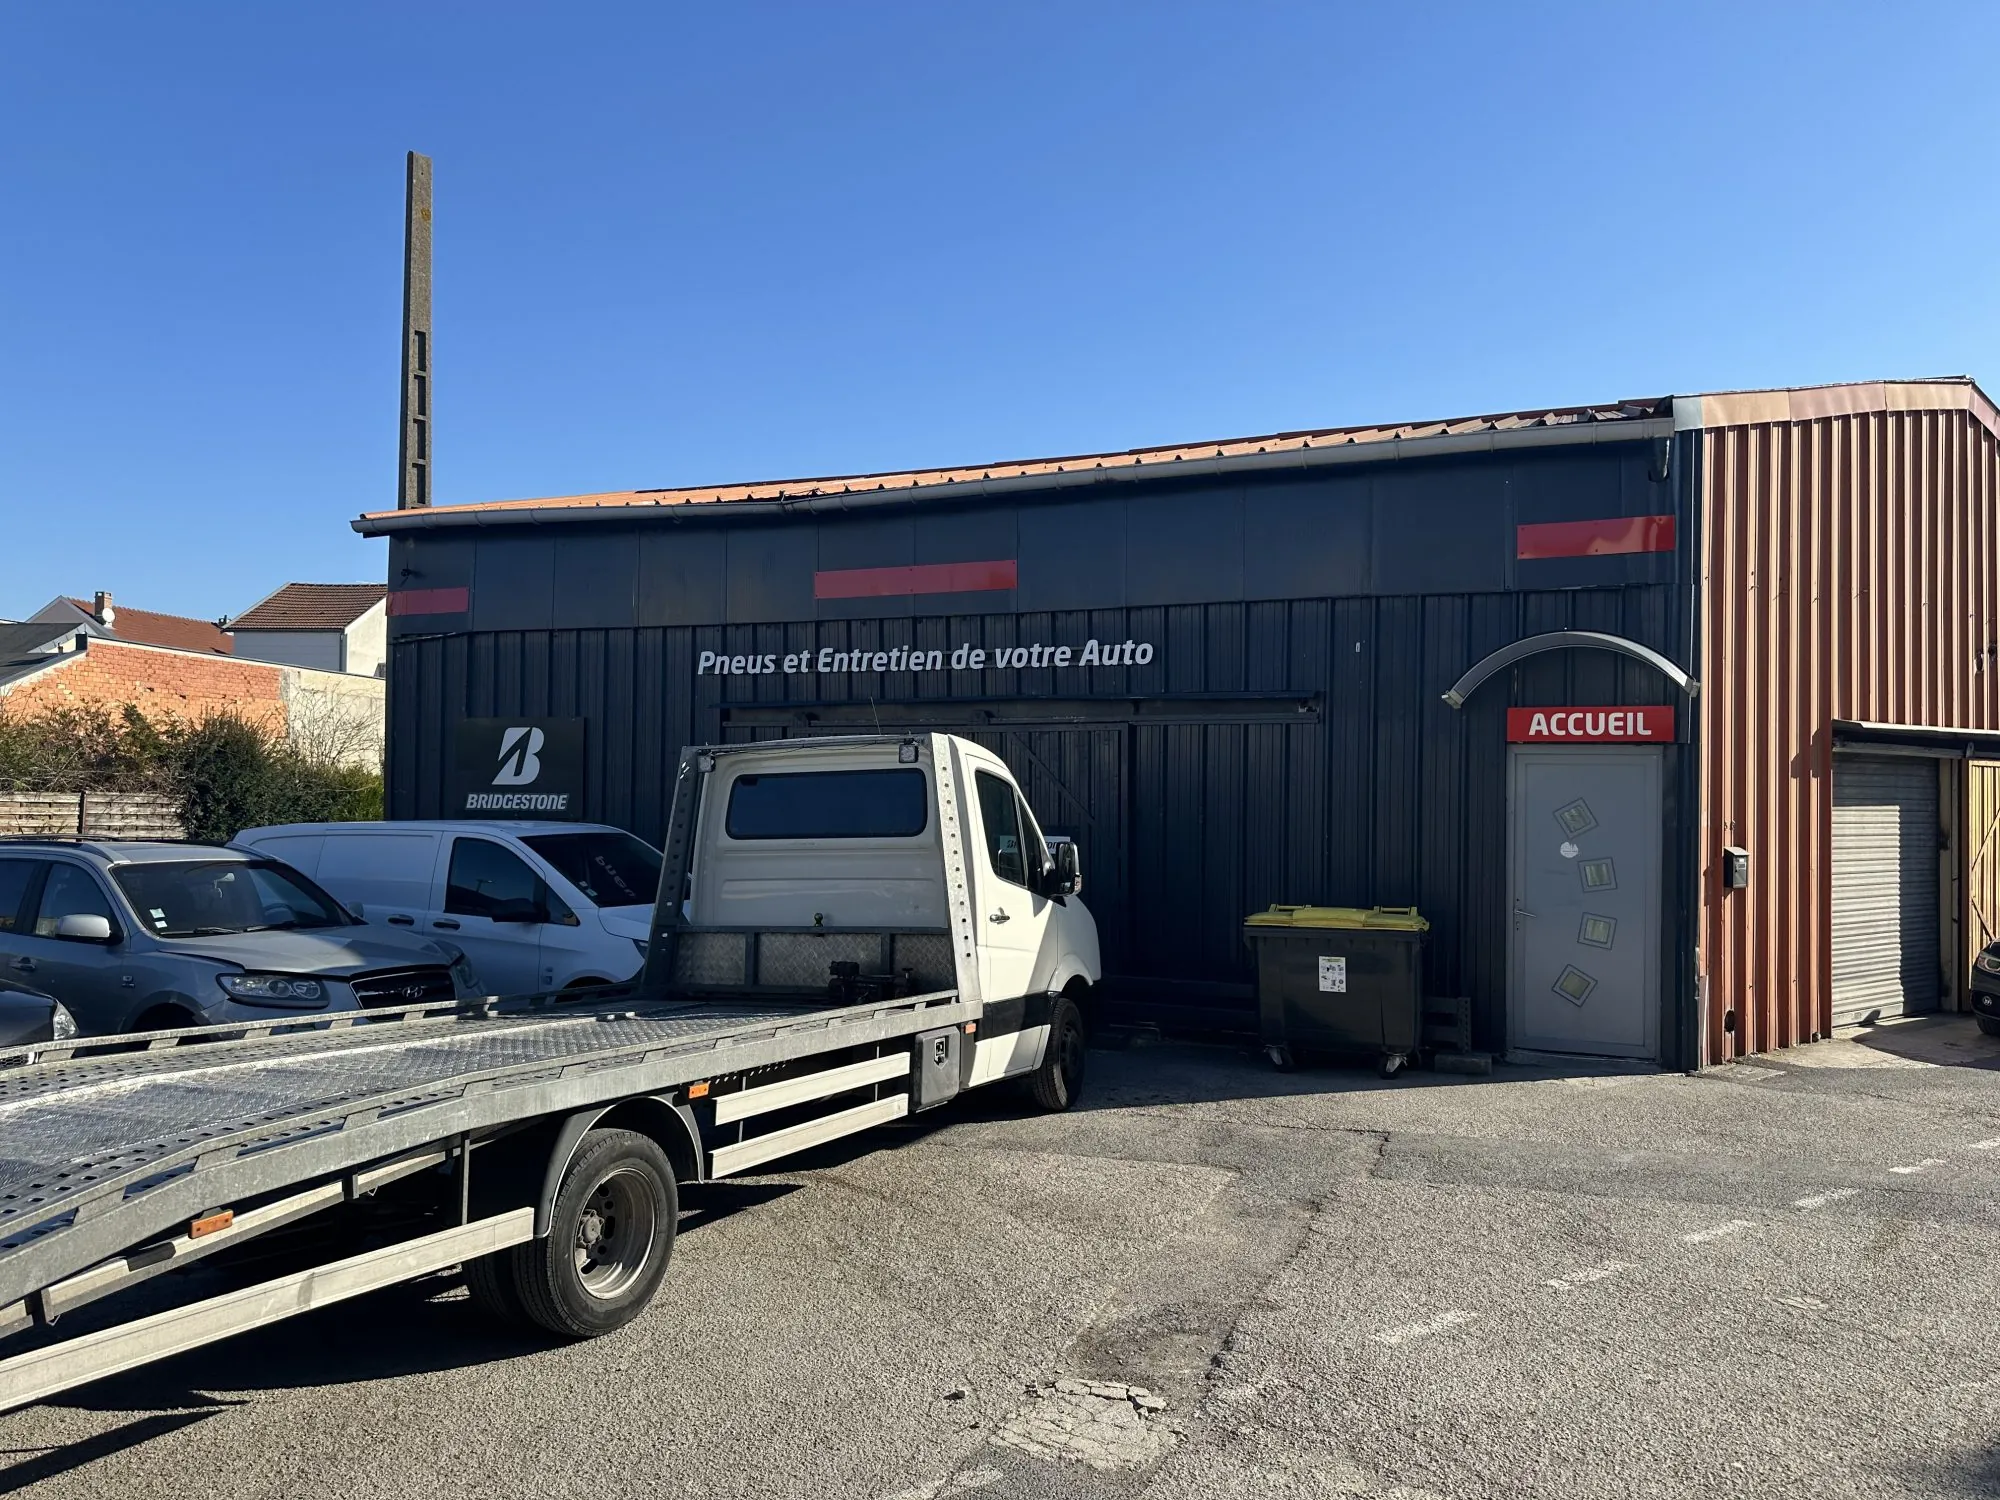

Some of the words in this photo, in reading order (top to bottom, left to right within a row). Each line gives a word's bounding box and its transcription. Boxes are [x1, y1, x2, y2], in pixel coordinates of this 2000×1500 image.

[697, 650, 776, 675] Pneus
[783, 650, 811, 673] et
[817, 645, 942, 673] Entretien
[951, 643, 985, 670] de
[995, 643, 1072, 668] votre
[1079, 639, 1154, 667] Auto
[1528, 712, 1652, 736] ACCUEIL
[466, 793, 568, 810] BRIDGESTONE
